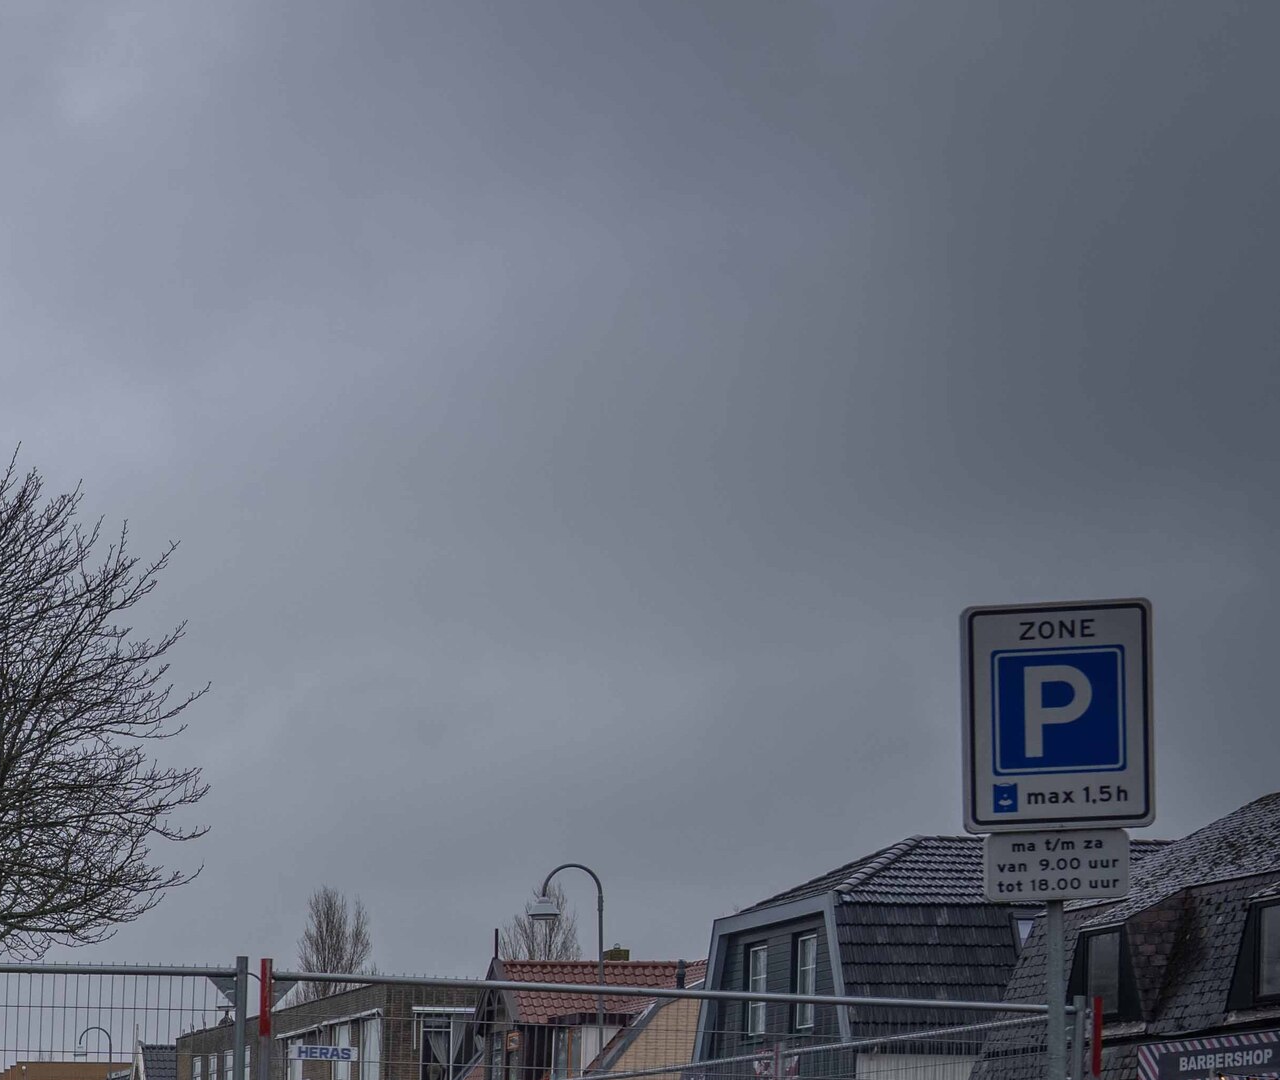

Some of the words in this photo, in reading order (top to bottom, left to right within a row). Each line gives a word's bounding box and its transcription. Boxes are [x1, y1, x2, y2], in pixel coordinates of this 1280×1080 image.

[1019, 619, 1095, 640] ZONE
[1024, 664, 1093, 758] P
[1027, 790, 1075, 805] max
[1011, 842, 1036, 852] ma
[1045, 838, 1075, 852] t/m
[1083, 839, 1104, 849] za
[997, 862, 1028, 873] van
[1039, 857, 1081, 871] 9.00
[1088, 859, 1120, 869] uur
[997, 881, 1023, 893] tot
[1030, 877, 1081, 891] 18.00
[1089, 878, 1120, 889] uur
[298, 1046, 351, 1060] HERAS
[1179, 1048, 1273, 1072] BARBERSHOP
